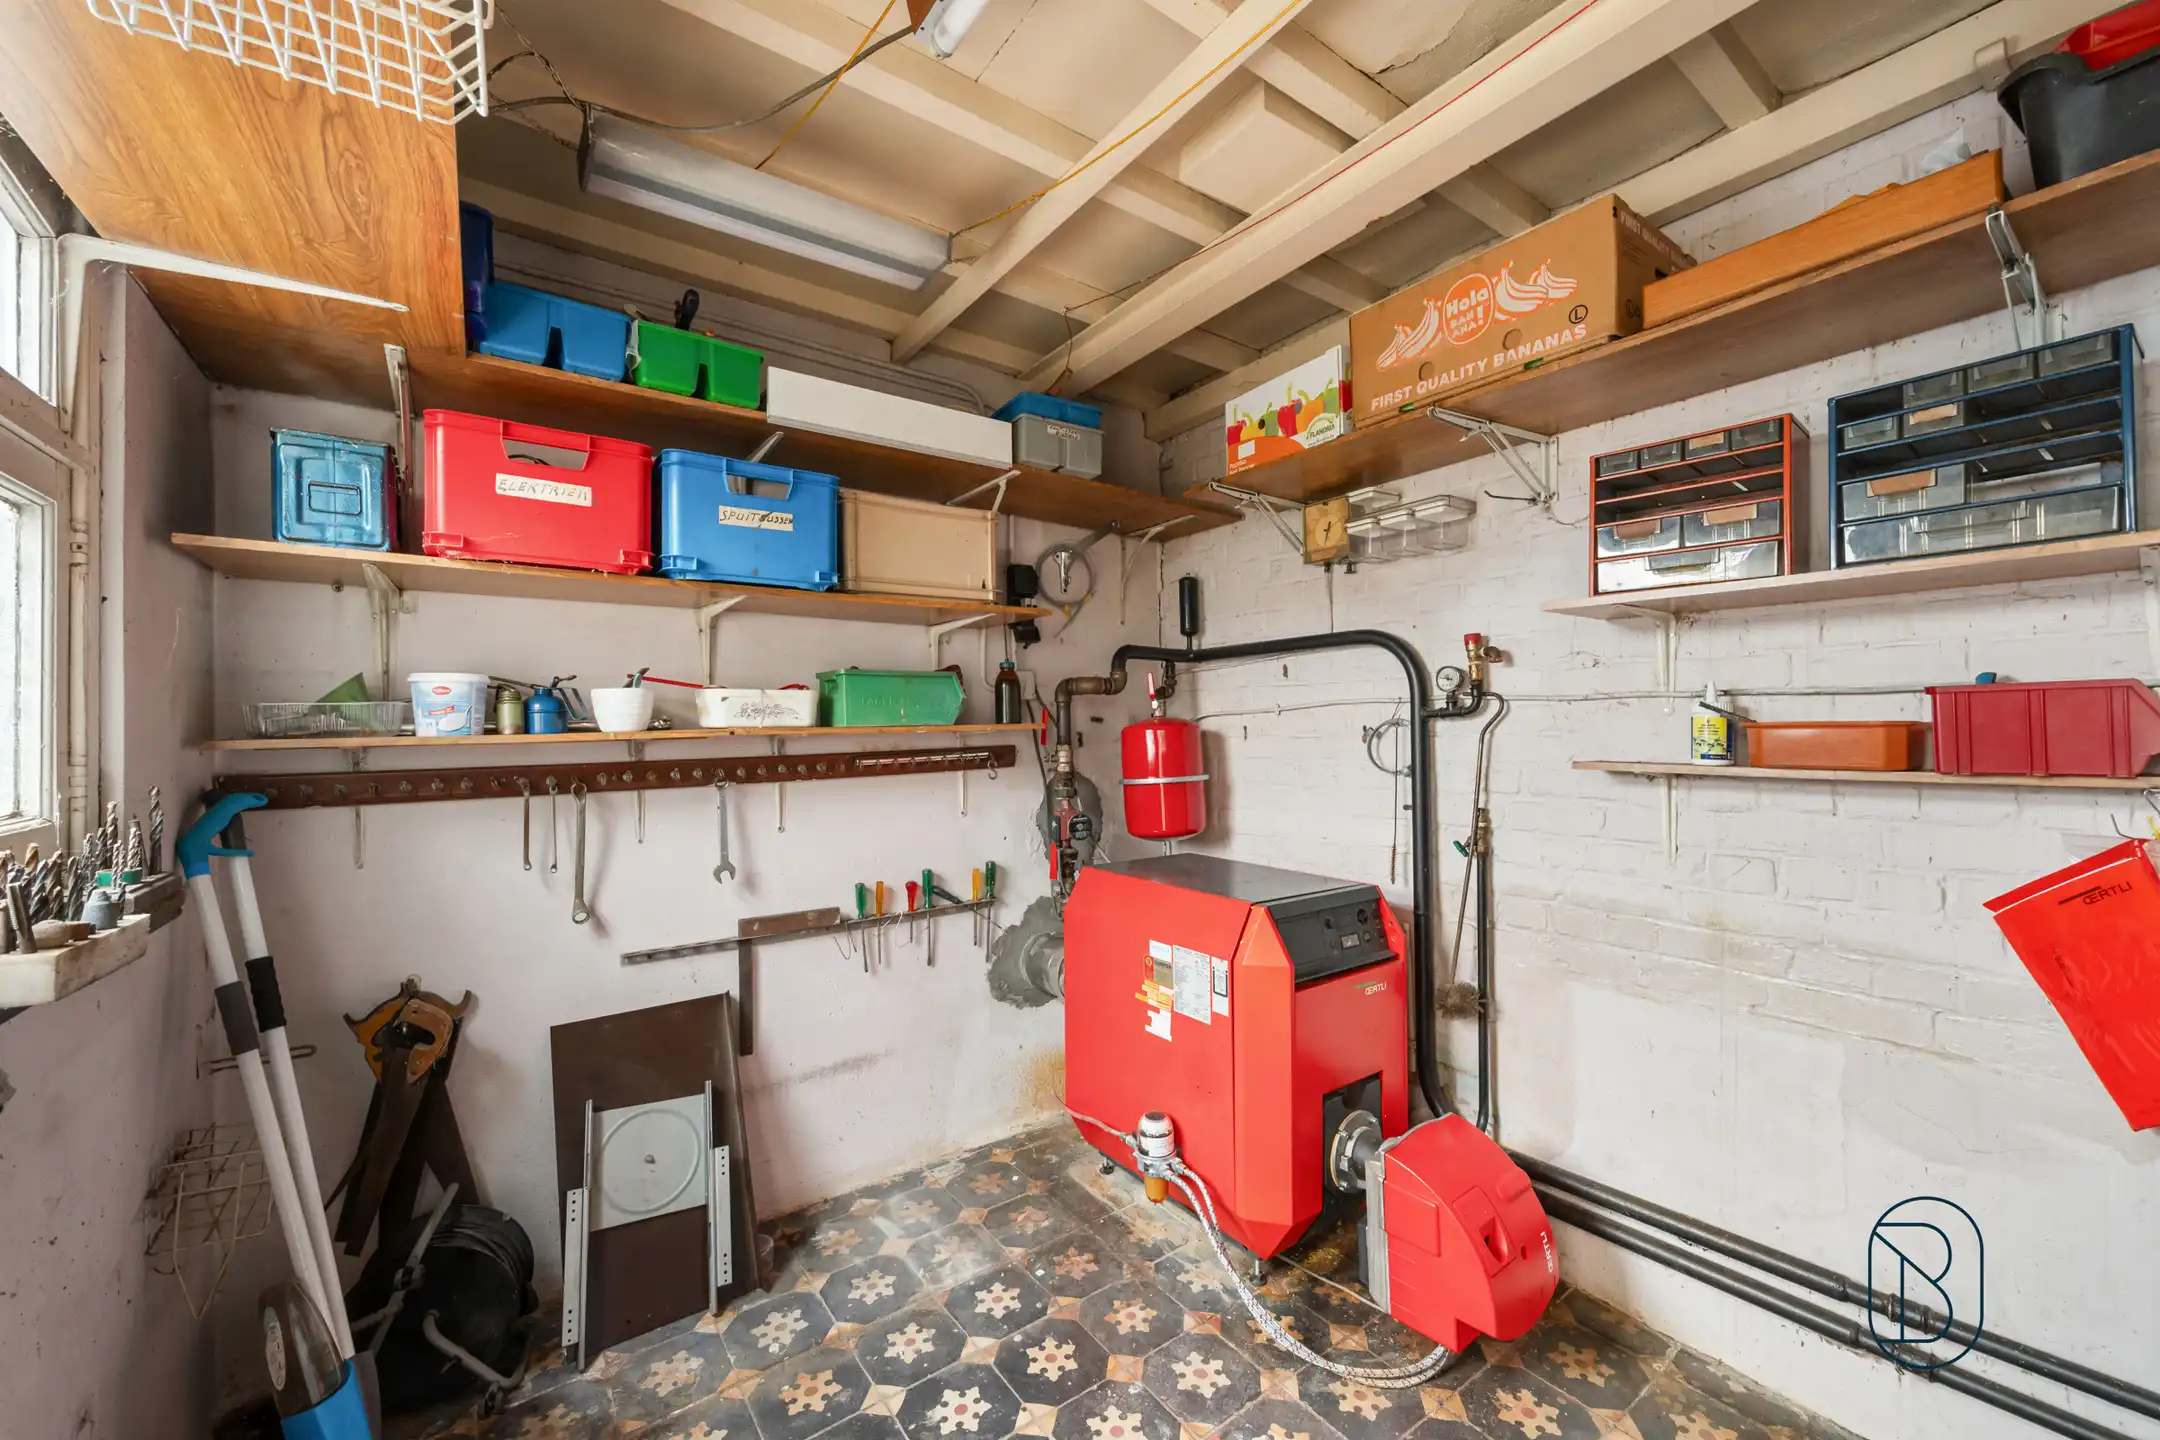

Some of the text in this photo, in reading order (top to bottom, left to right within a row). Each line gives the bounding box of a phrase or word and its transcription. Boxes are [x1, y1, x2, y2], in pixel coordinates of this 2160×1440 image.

[1446, 287, 1489, 319] Hola
[1371, 323, 1588, 411] FIRST QUALITY BANANAS
[1309, 423, 1336, 439] FLANDRIA
